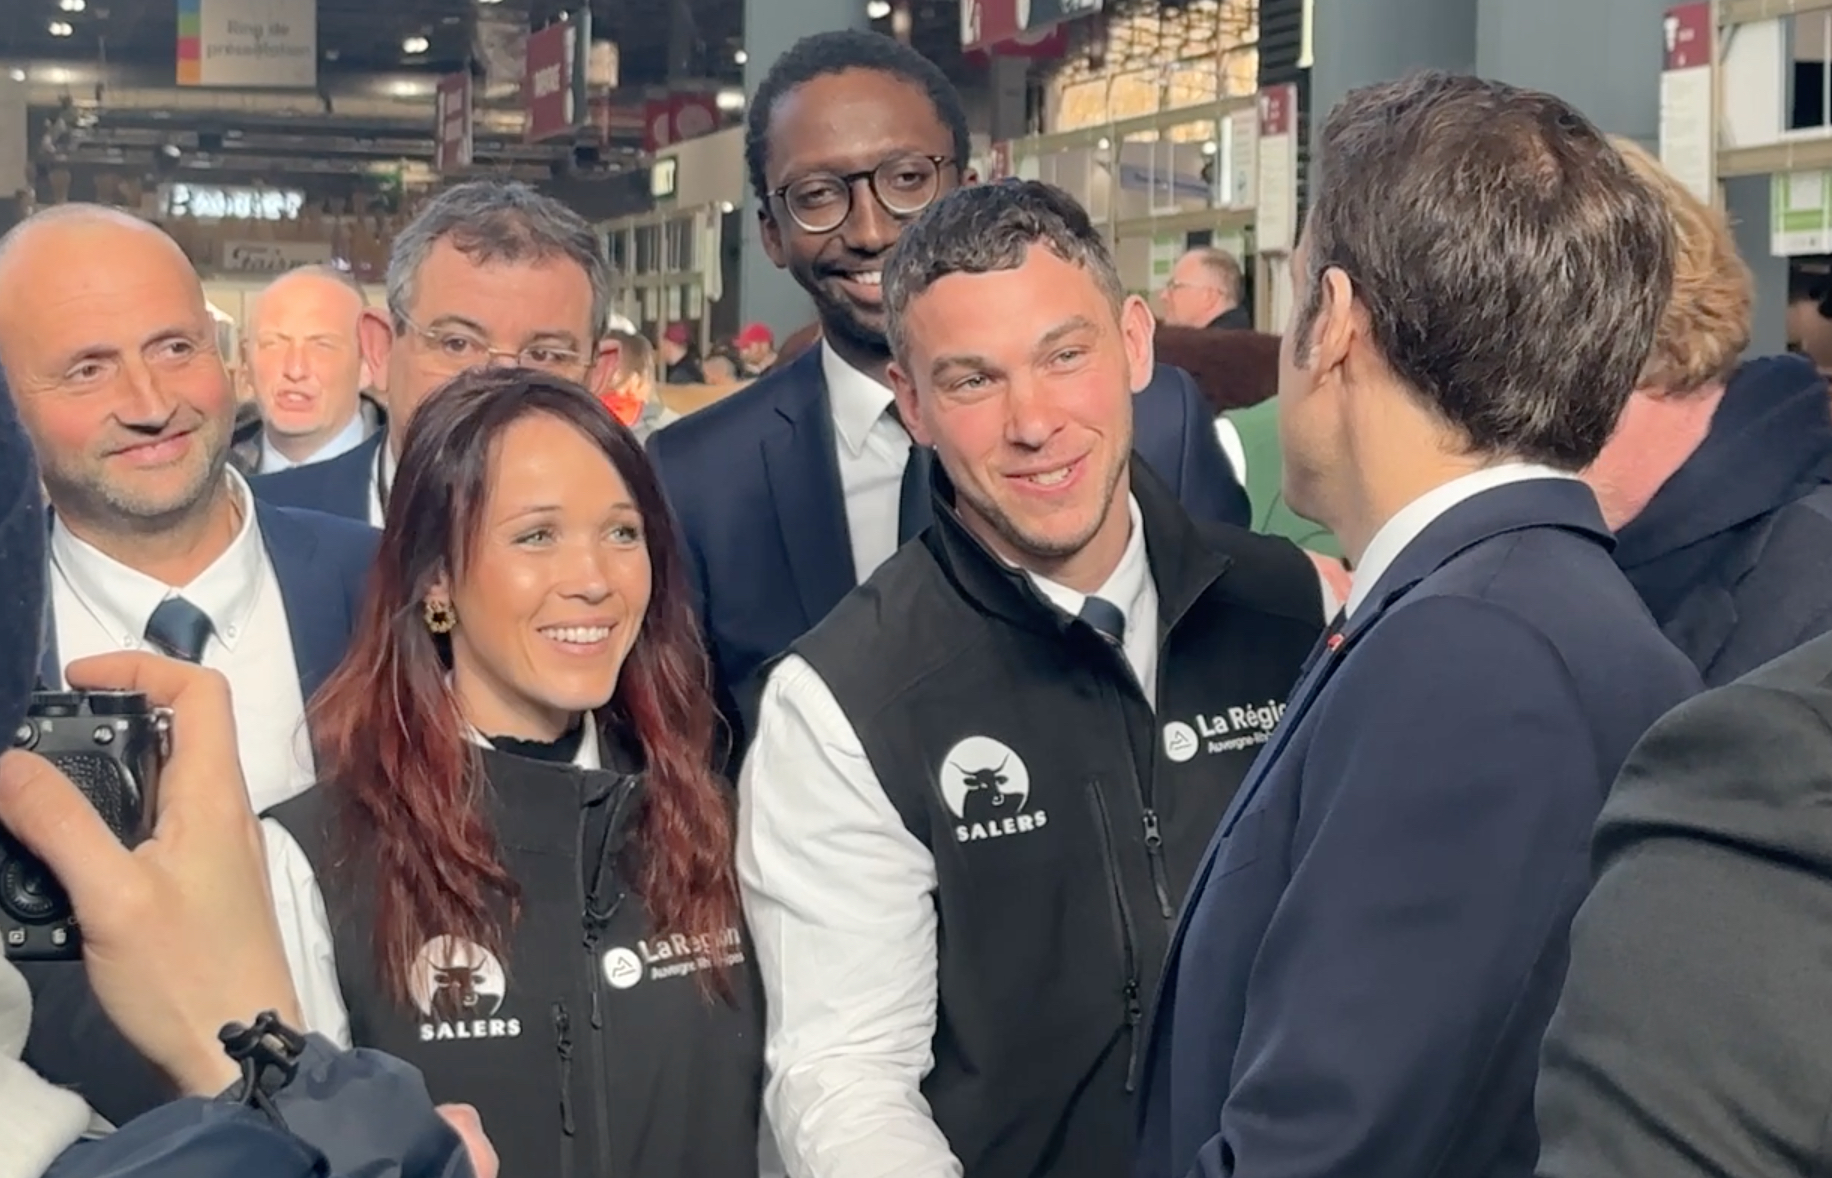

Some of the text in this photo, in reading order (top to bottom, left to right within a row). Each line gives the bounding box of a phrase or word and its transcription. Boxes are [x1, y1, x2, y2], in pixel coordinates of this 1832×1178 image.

[1196, 714, 1229, 737] La
[956, 809, 1047, 842] SALERS
[638, 940, 674, 962] La
[420, 1018, 521, 1041] SALERS
